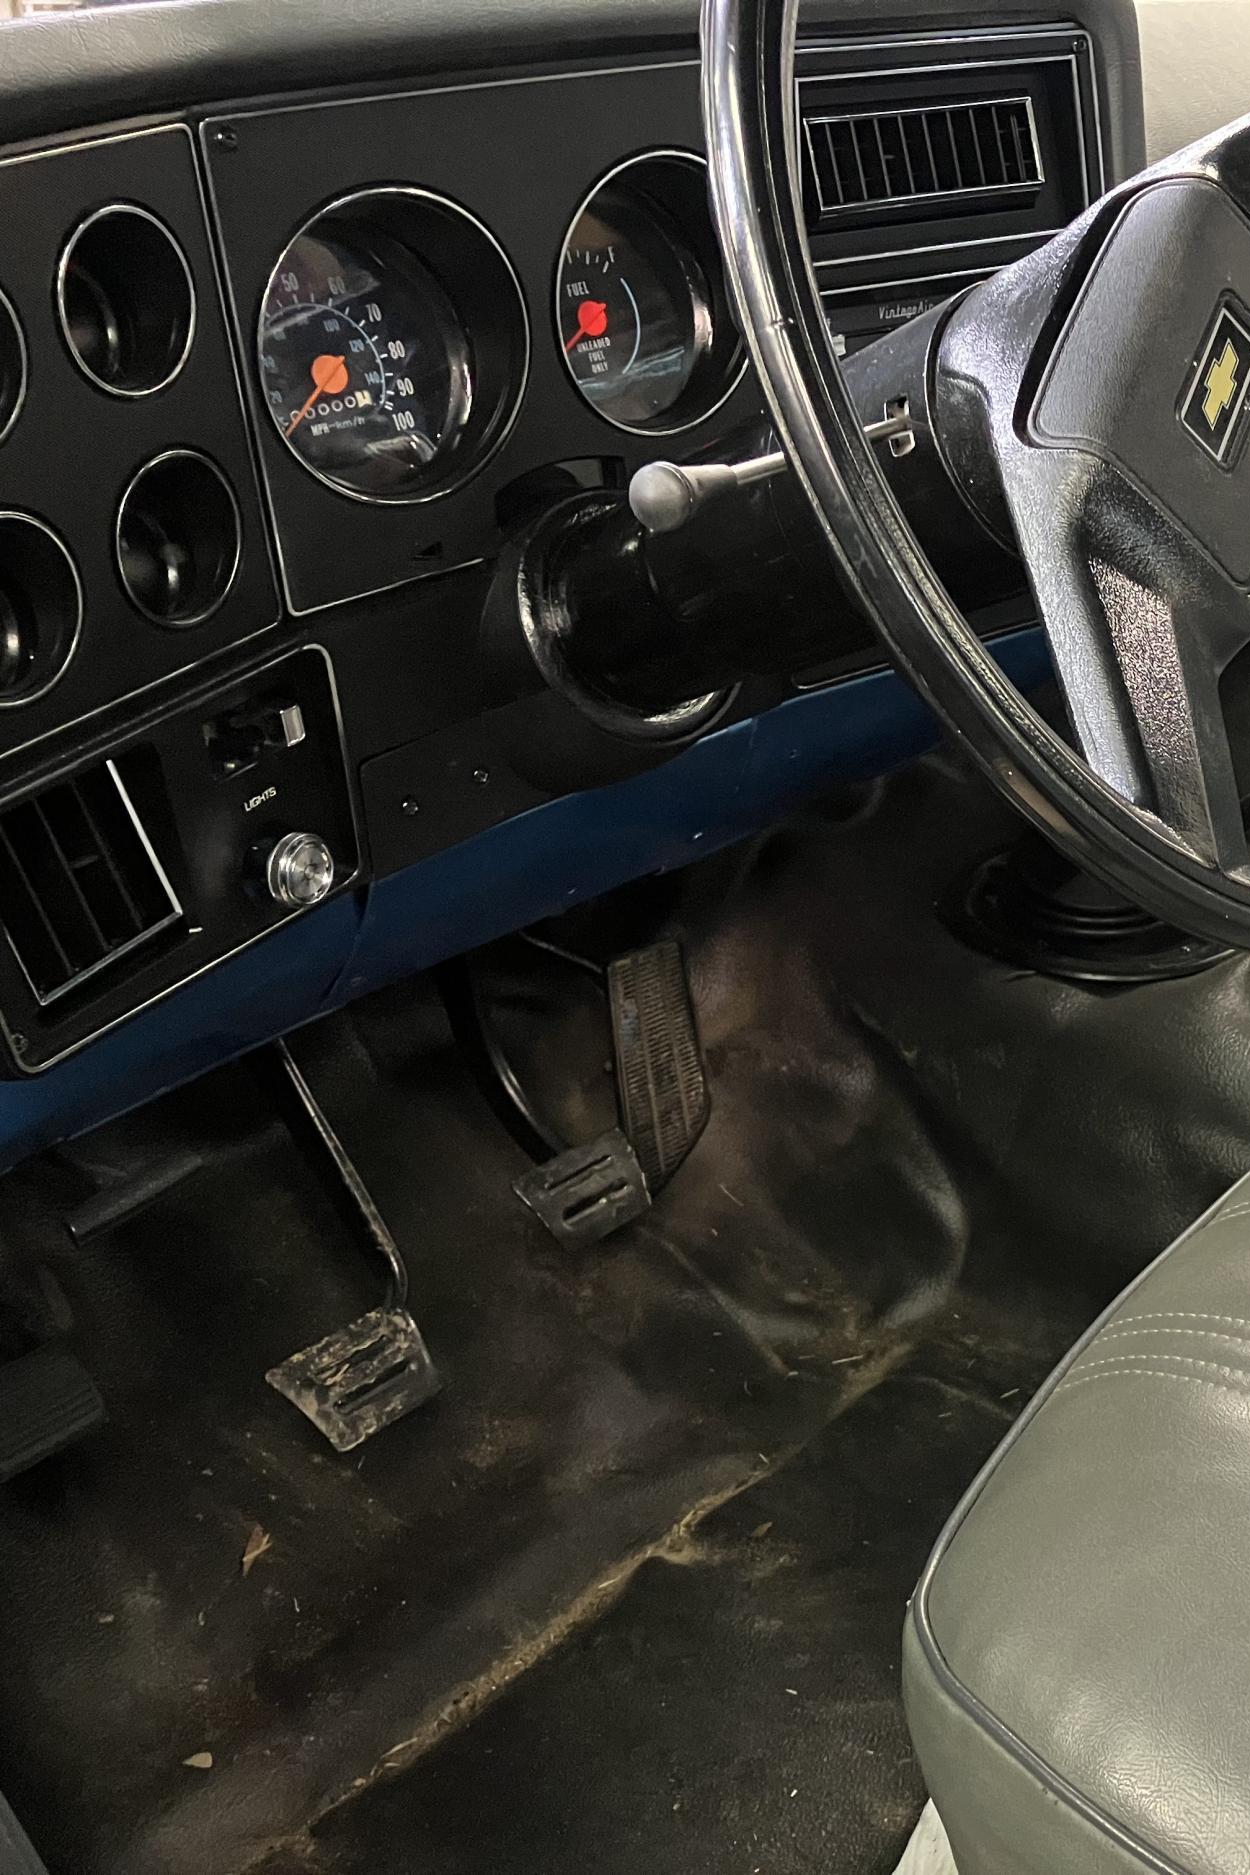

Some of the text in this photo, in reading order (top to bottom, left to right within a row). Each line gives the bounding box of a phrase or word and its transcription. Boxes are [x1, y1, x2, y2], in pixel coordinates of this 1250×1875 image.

[280, 271, 300, 293] 50
[327, 276, 346, 295] 60
[566, 280, 590, 298] FUEL
[365, 302, 382, 323] 70
[387, 339, 406, 360] 80
[575, 336, 611, 353] UNLEADED
[588, 350, 606, 363] FUEL
[591, 361, 608, 374] ONLY
[396, 376, 415, 397] 90
[392, 410, 416, 432] 100
[243, 786, 278, 812] LIGHTS
